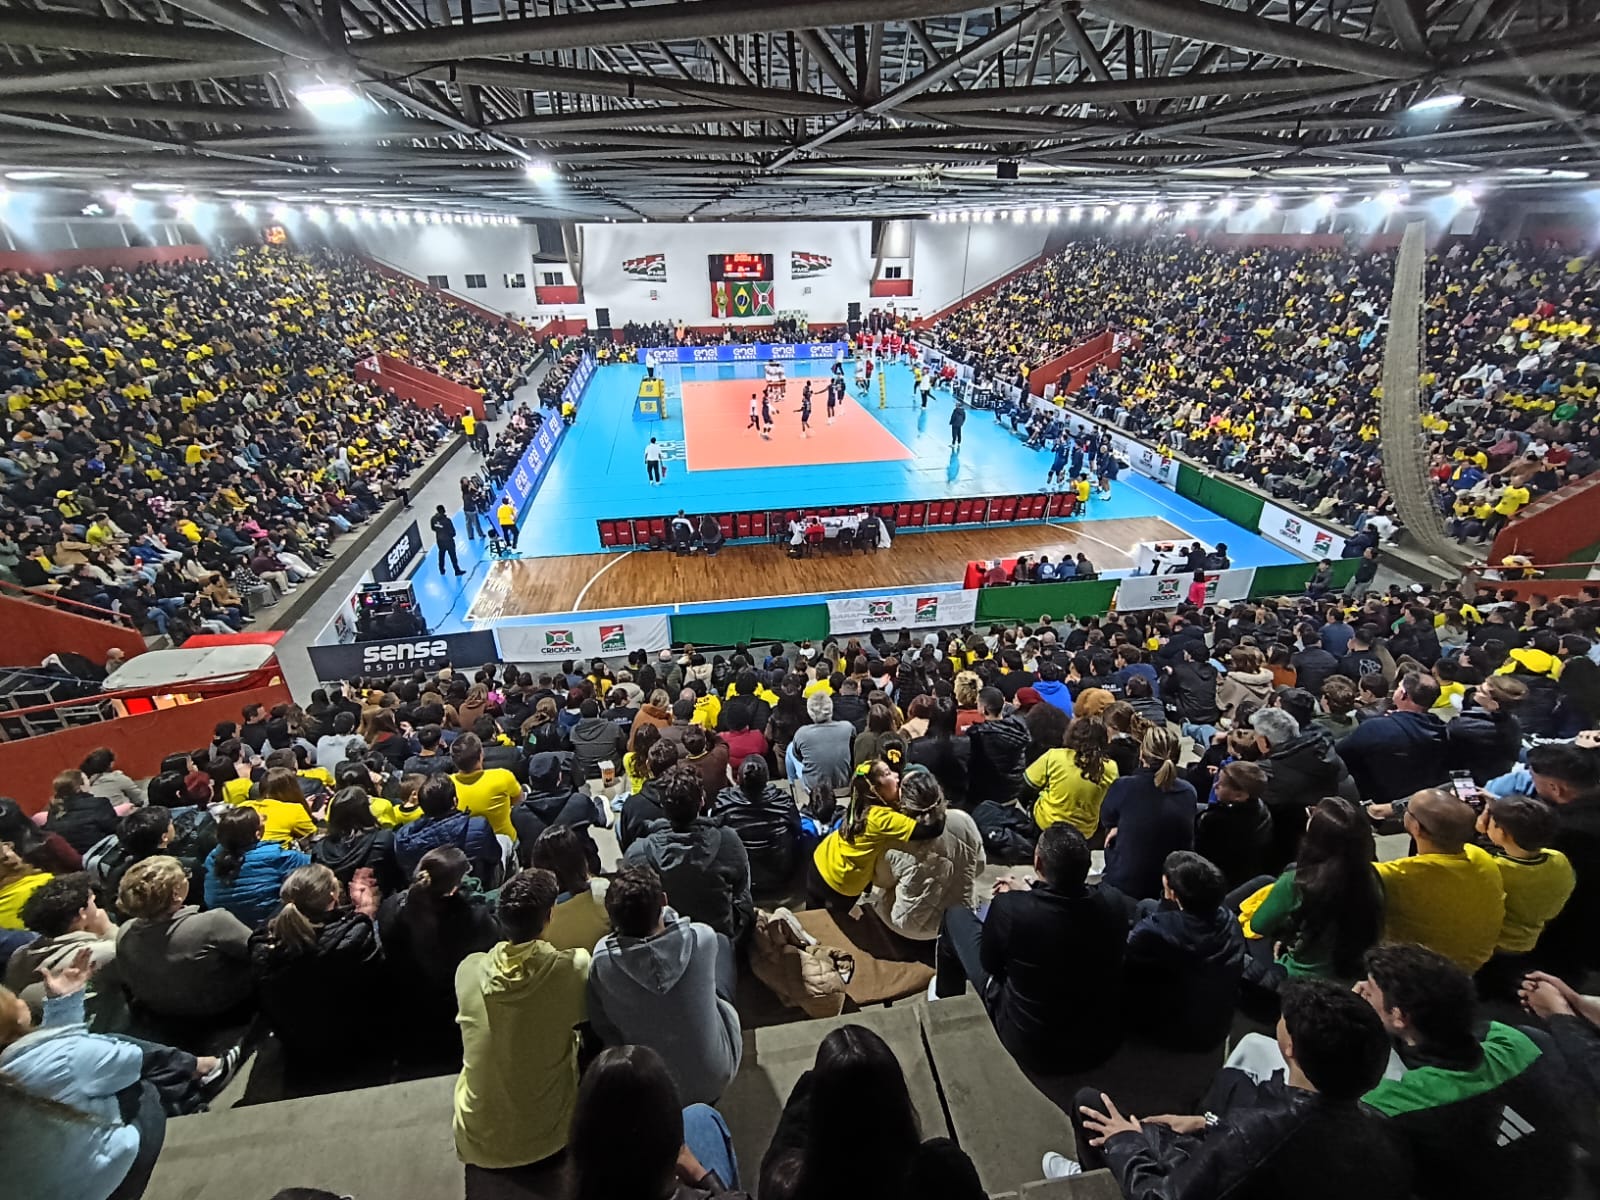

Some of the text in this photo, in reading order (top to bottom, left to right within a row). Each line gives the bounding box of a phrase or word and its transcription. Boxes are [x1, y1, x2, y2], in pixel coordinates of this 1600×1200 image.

[653, 348, 678, 358] enel
[694, 347, 718, 357] enel
[733, 345, 756, 356] enel
[772, 344, 795, 355] enel
[810, 343, 833, 354] enel
[364, 659, 436, 672] esporte
